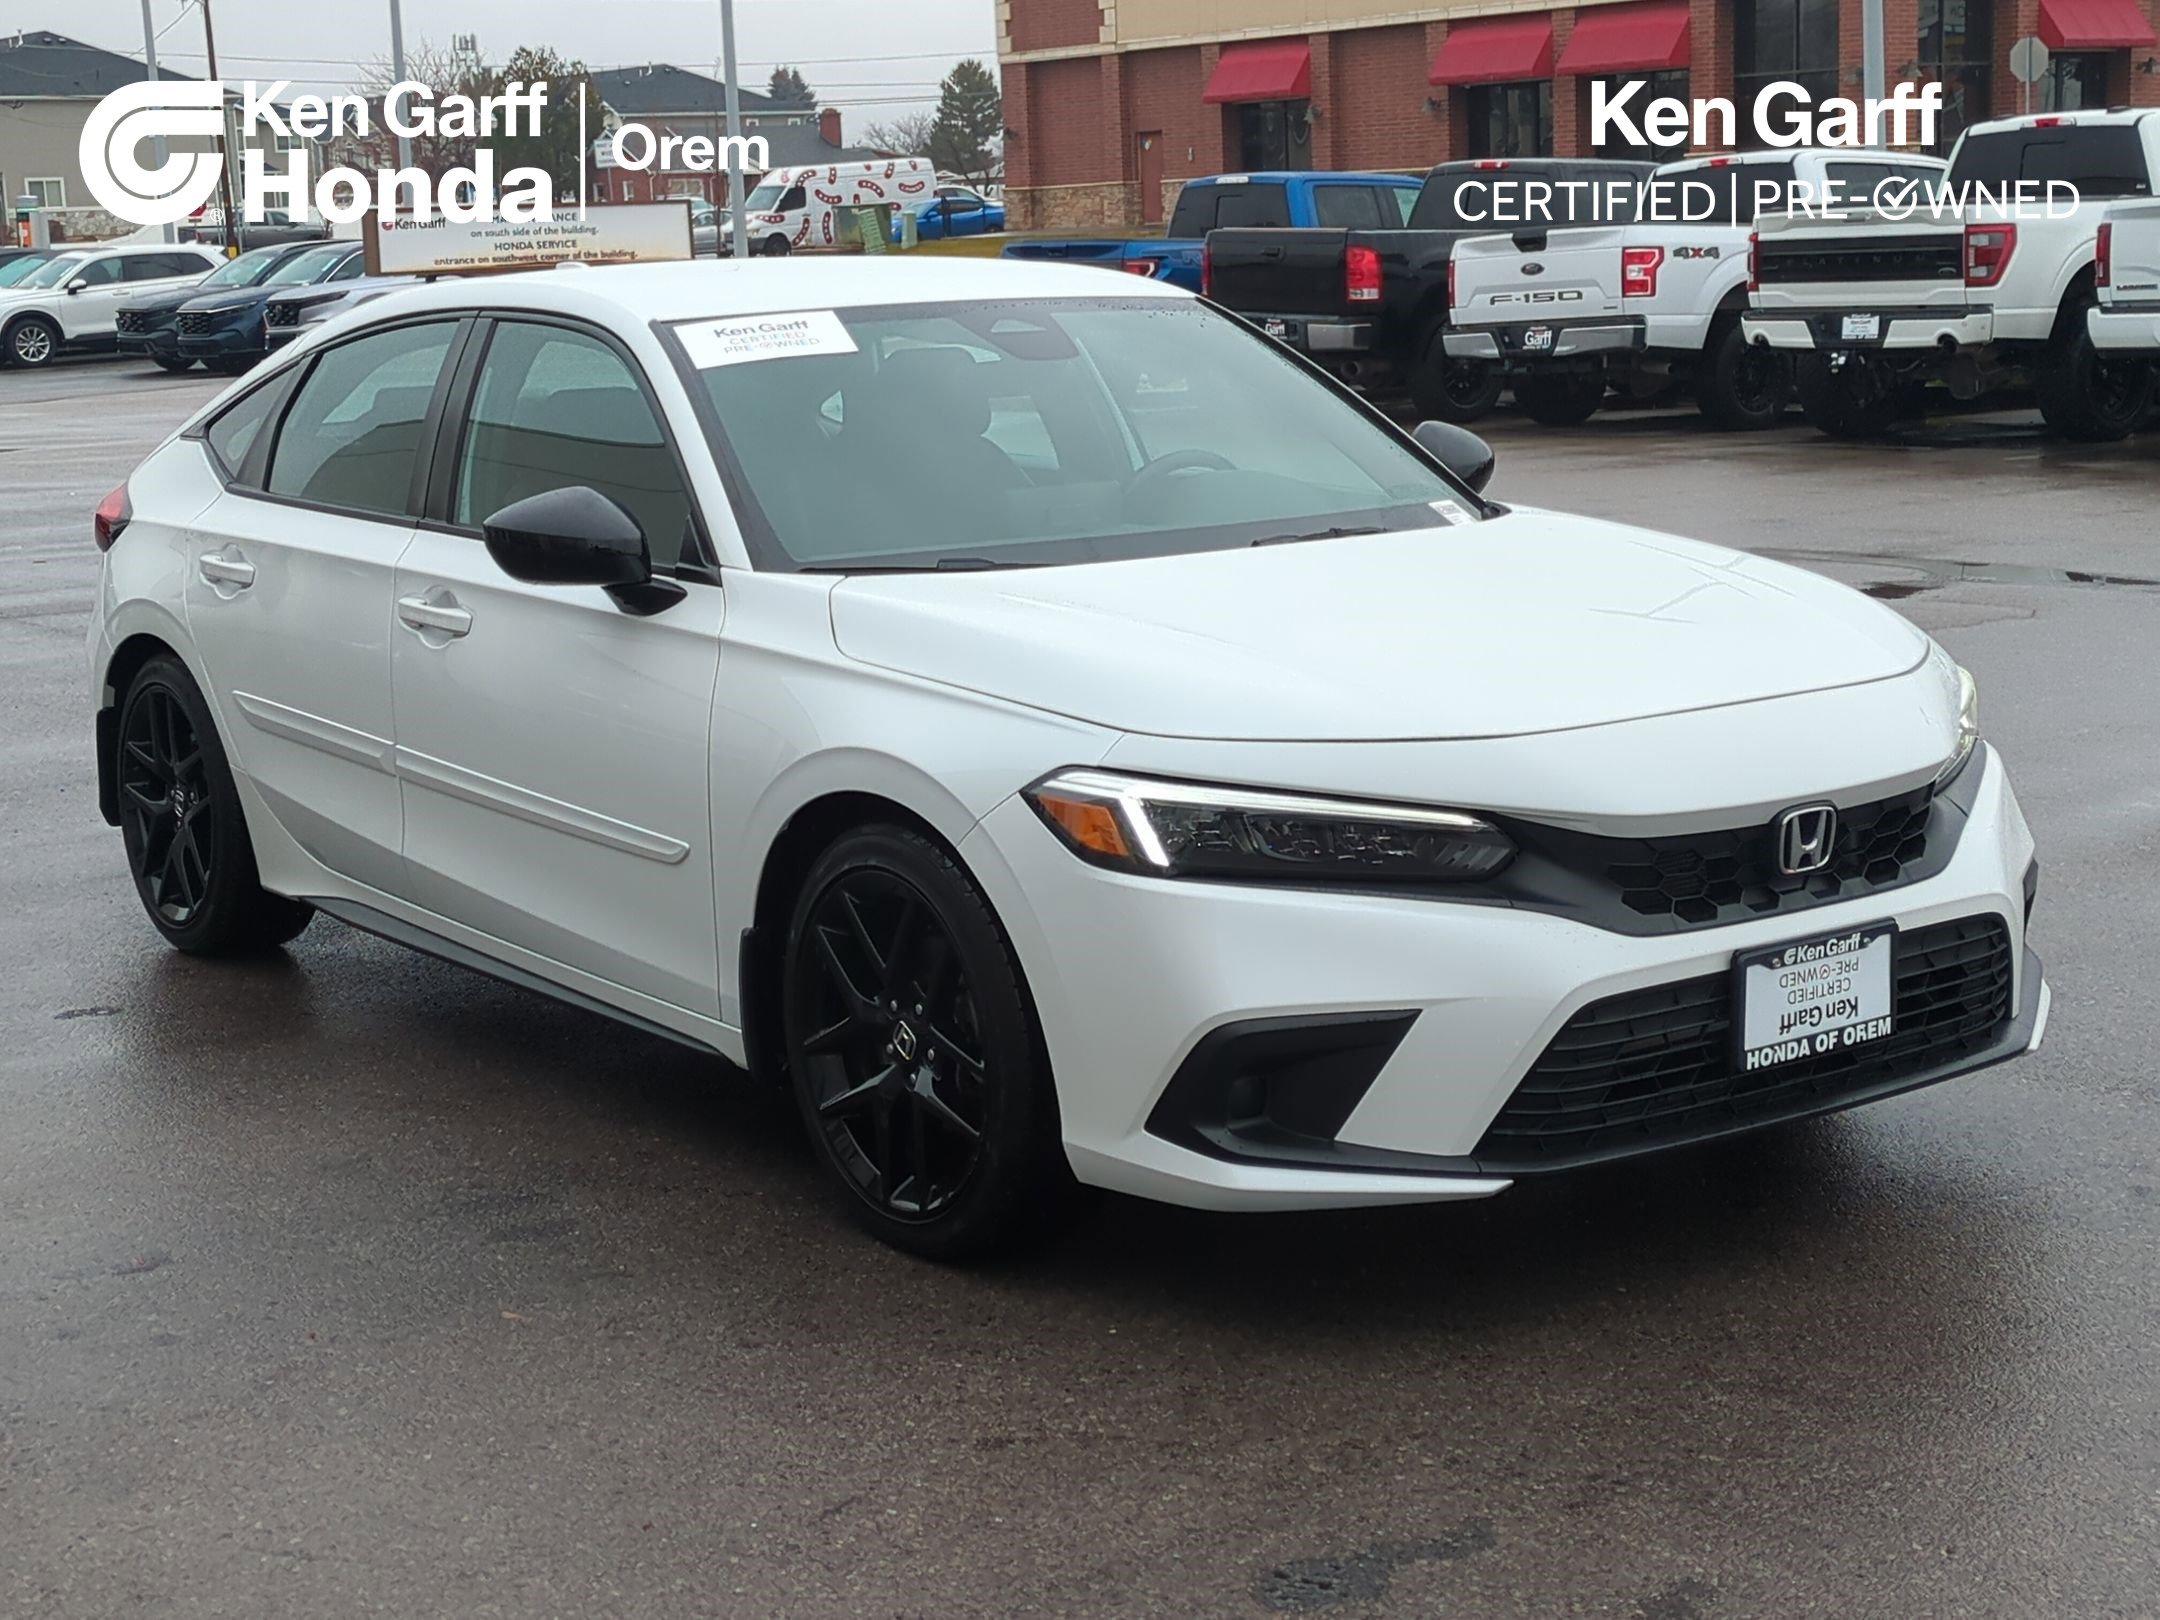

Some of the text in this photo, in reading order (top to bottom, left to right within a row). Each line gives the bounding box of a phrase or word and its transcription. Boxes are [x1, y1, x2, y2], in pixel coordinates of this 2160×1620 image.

[395, 218, 416, 230] Ken
[485, 228, 509, 237] south
[513, 227, 530, 236] side
[533, 226, 543, 235] of
[545, 226, 559, 235] the
[494, 239, 578, 250] HONDA SERVICE
[434, 257, 475, 266] entrance
[492, 252, 538, 263] southwest
[540, 253, 570, 261] corner
[573, 251, 582, 259] of
[584, 250, 598, 259] the
[1490, 290, 1583, 306] F-150
[714, 320, 809, 339] Ken Garff
[729, 331, 806, 345] CERTIFIED
[1525, 330, 1552, 347] Garff
[1797, 932, 1861, 963] Ken Garff
[1787, 977, 1851, 1005] CERTIFIED
[1779, 996, 1858, 1035] Ken Garff
[1746, 1016, 1891, 1071] HONDA OF OREM
